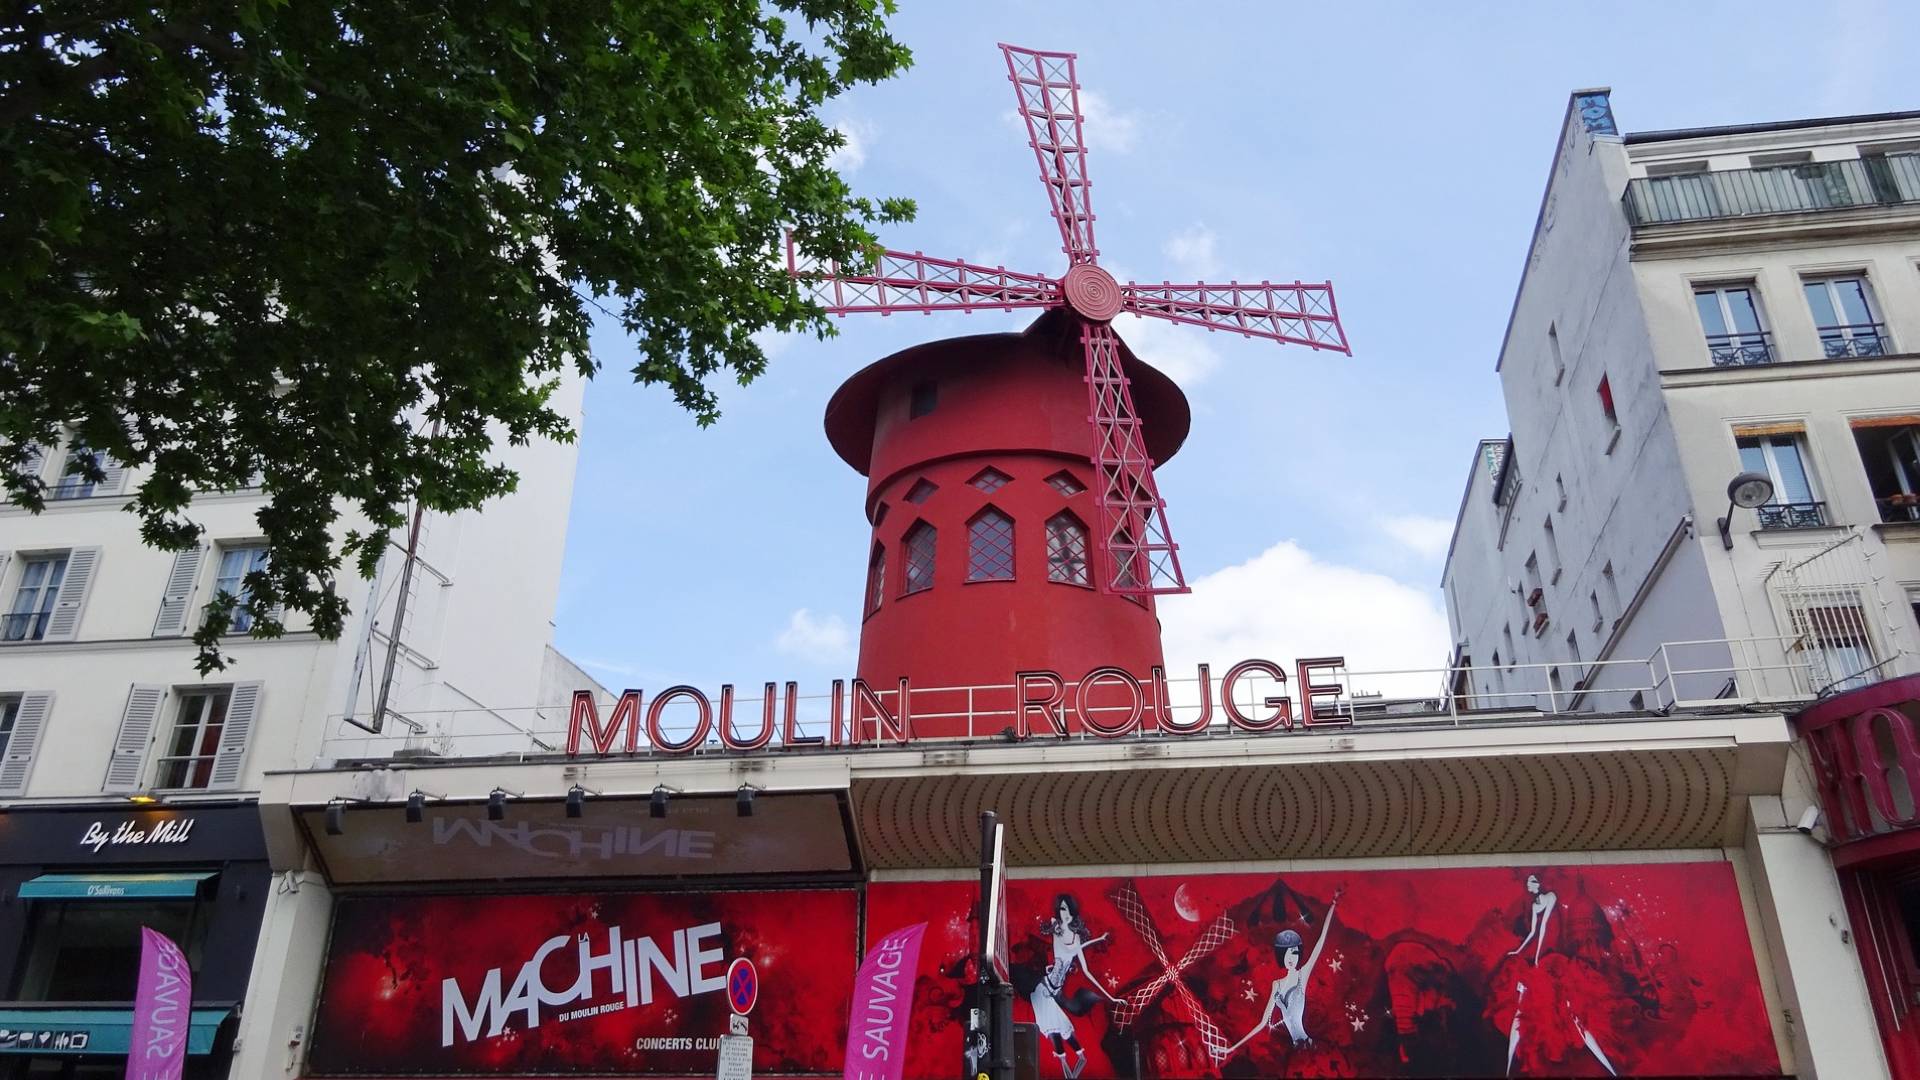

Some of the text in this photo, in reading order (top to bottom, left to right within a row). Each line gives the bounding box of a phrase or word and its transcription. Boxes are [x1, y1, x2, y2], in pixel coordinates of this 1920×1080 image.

[567, 656, 1353, 755] MOULIN ROUGE
[80, 818, 195, 853] By the Mill
[577, 931, 590, 943] LA
[441, 921, 728, 1048] MACHINE
[862, 937, 908, 1062] SAUVAGE
[558, 1001, 625, 1022] DU MOULIN ROUGE
[636, 1037, 693, 1050] CONCERTS
